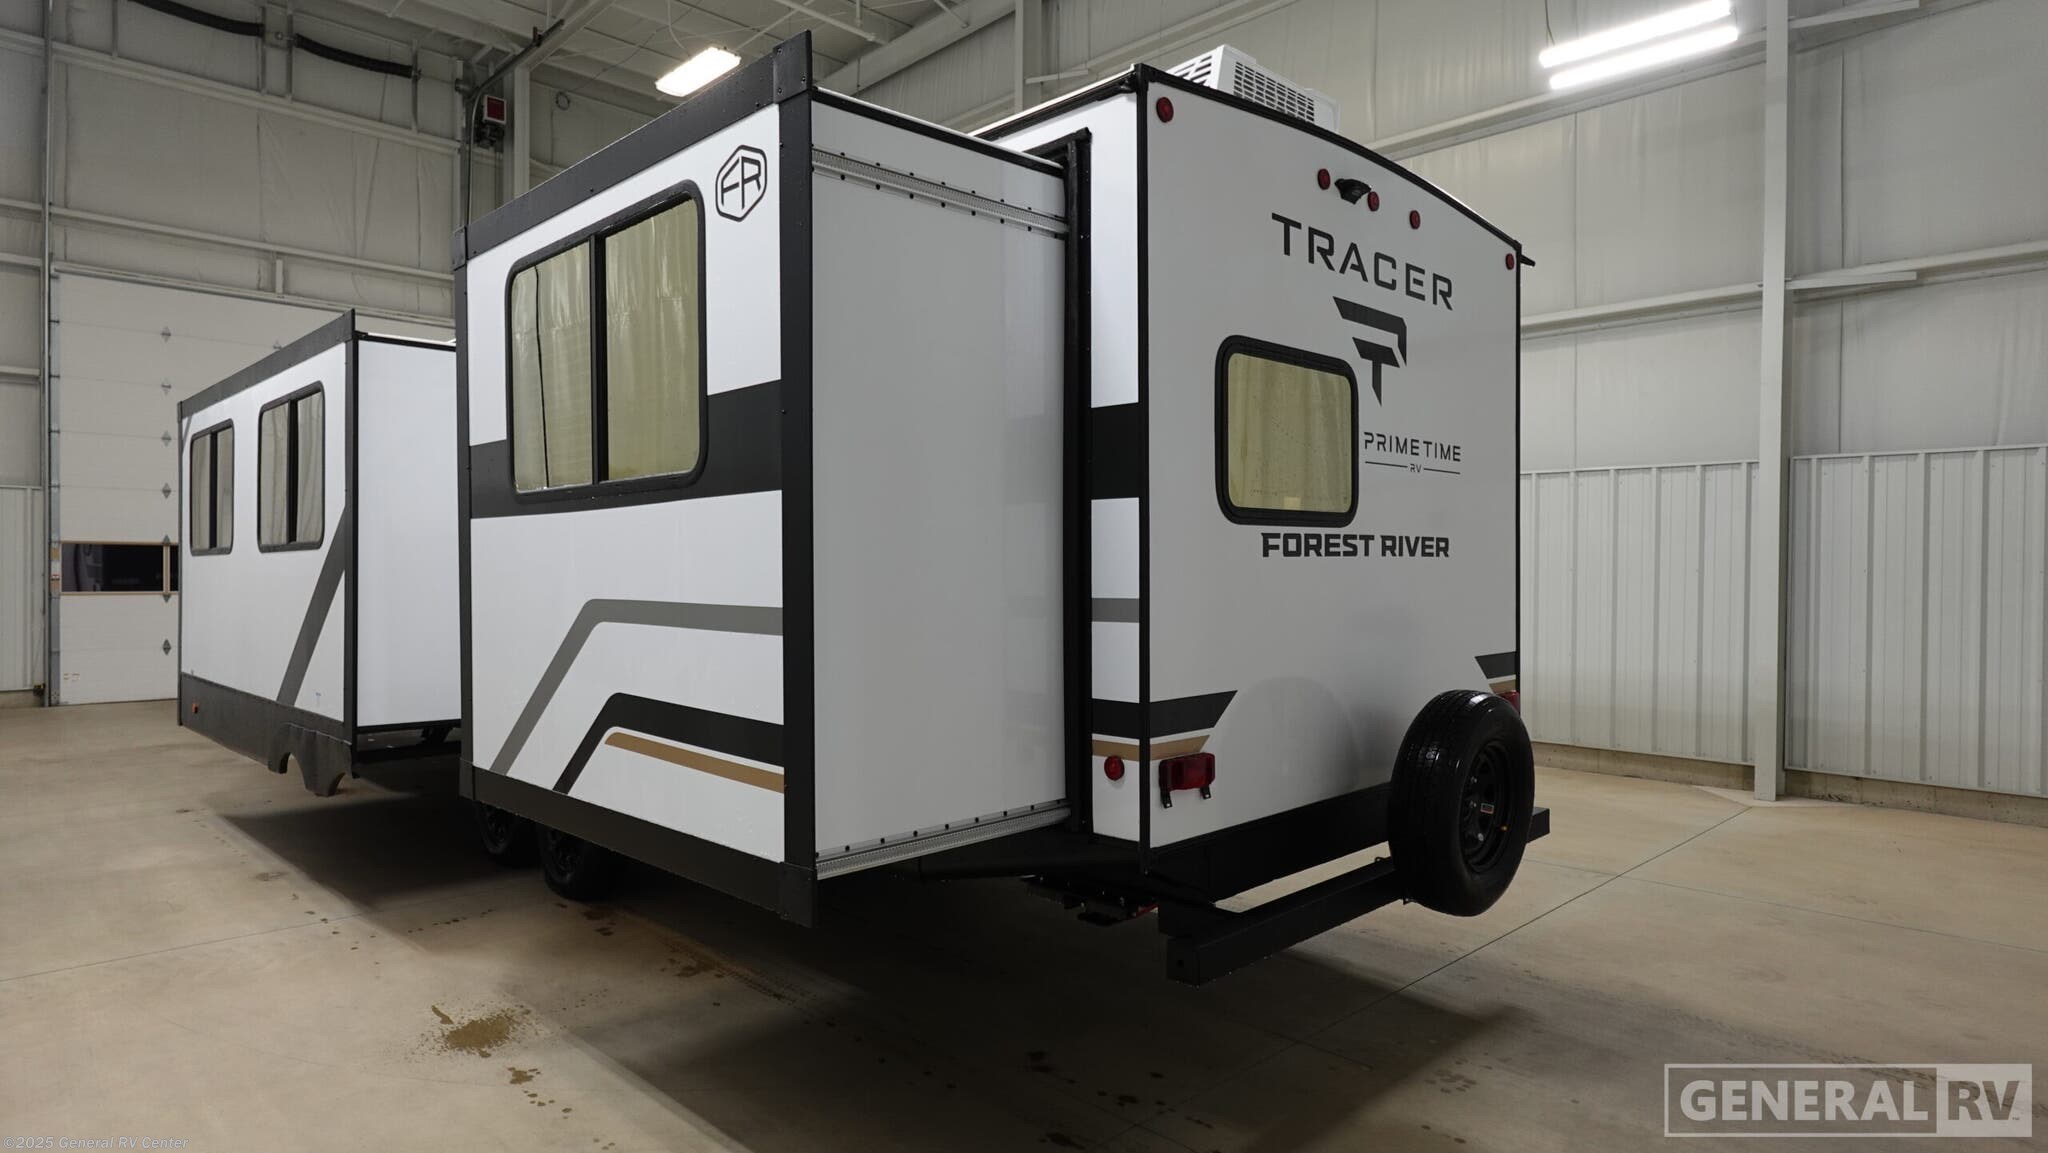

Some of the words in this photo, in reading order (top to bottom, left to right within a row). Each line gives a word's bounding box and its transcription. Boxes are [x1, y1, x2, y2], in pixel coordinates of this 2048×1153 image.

[1272, 212, 1453, 311] TRACER
[1410, 463, 1422, 473] RV
[1261, 532, 1375, 558] FOREST
[1380, 535, 1450, 558] RIVER
